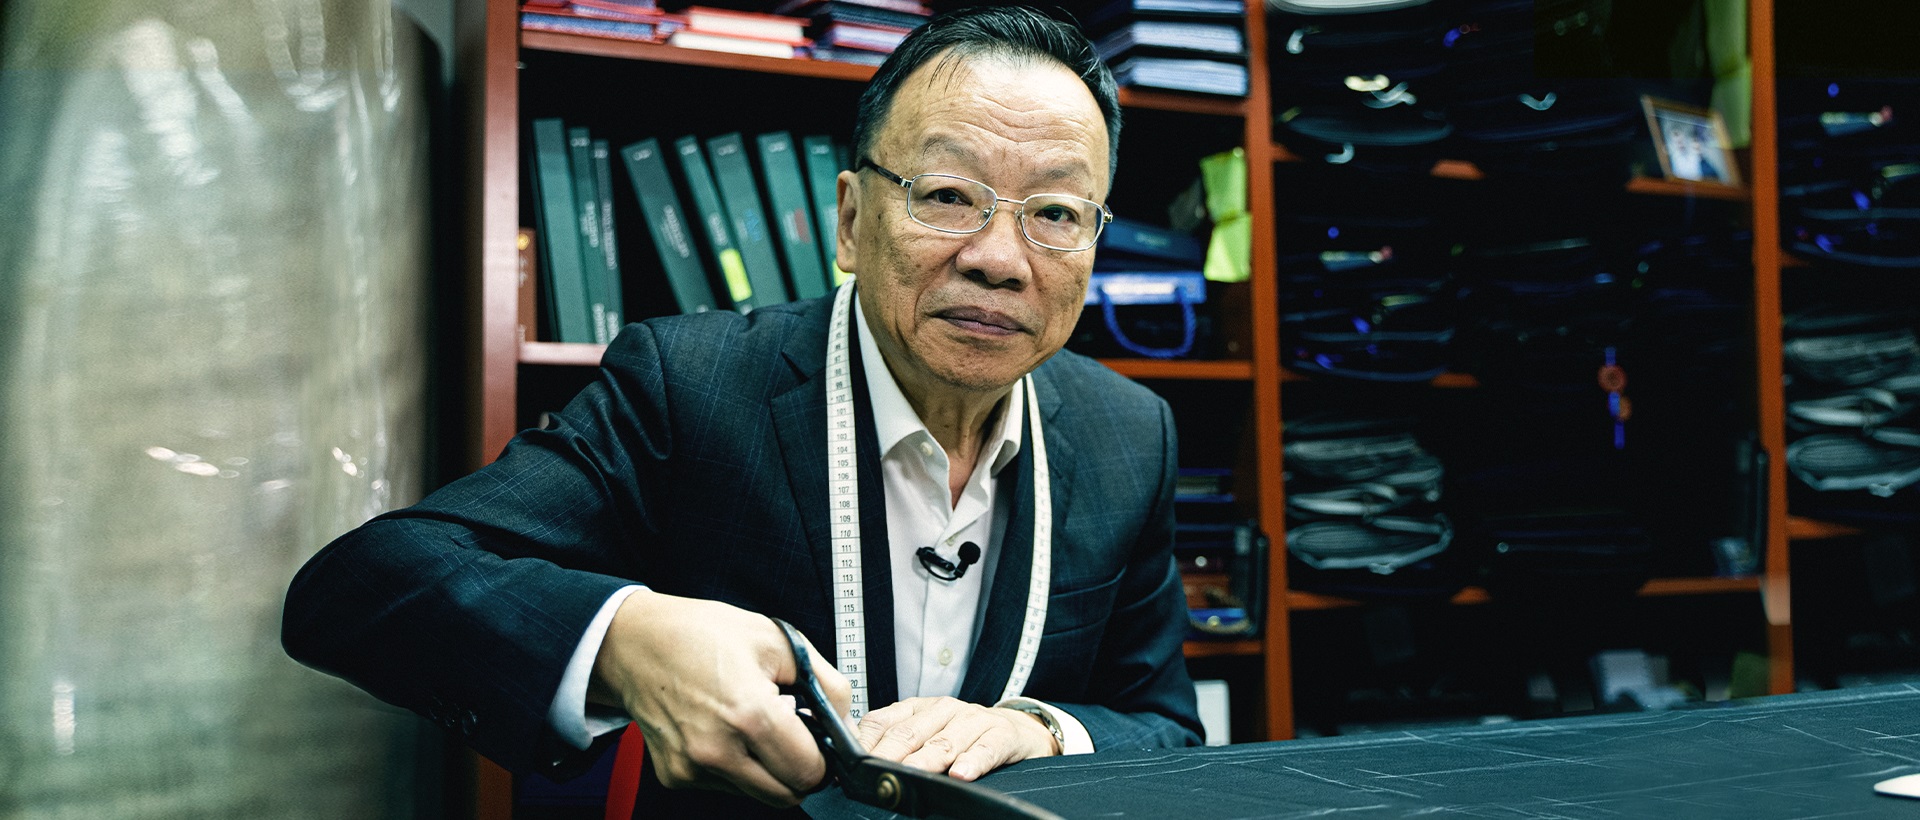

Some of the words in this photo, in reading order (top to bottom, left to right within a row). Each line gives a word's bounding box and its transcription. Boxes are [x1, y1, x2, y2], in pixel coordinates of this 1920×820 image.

[837, 446, 848, 454] 104
[837, 459, 849, 467] 105
[837, 472, 850, 480] 106
[838, 486, 850, 494] 107
[839, 500, 851, 508] 108
[839, 514, 851, 523] 109
[840, 529, 852, 538] 110
[841, 544, 852, 552] 111
[841, 559, 853, 568] 112
[842, 574, 854, 582] 113
[843, 589, 854, 597] 114
[843, 603, 855, 612] 115
[844, 619, 856, 627] 116
[845, 633, 856, 642] 117
[845, 649, 857, 657] 118
[846, 664, 858, 672] 119
